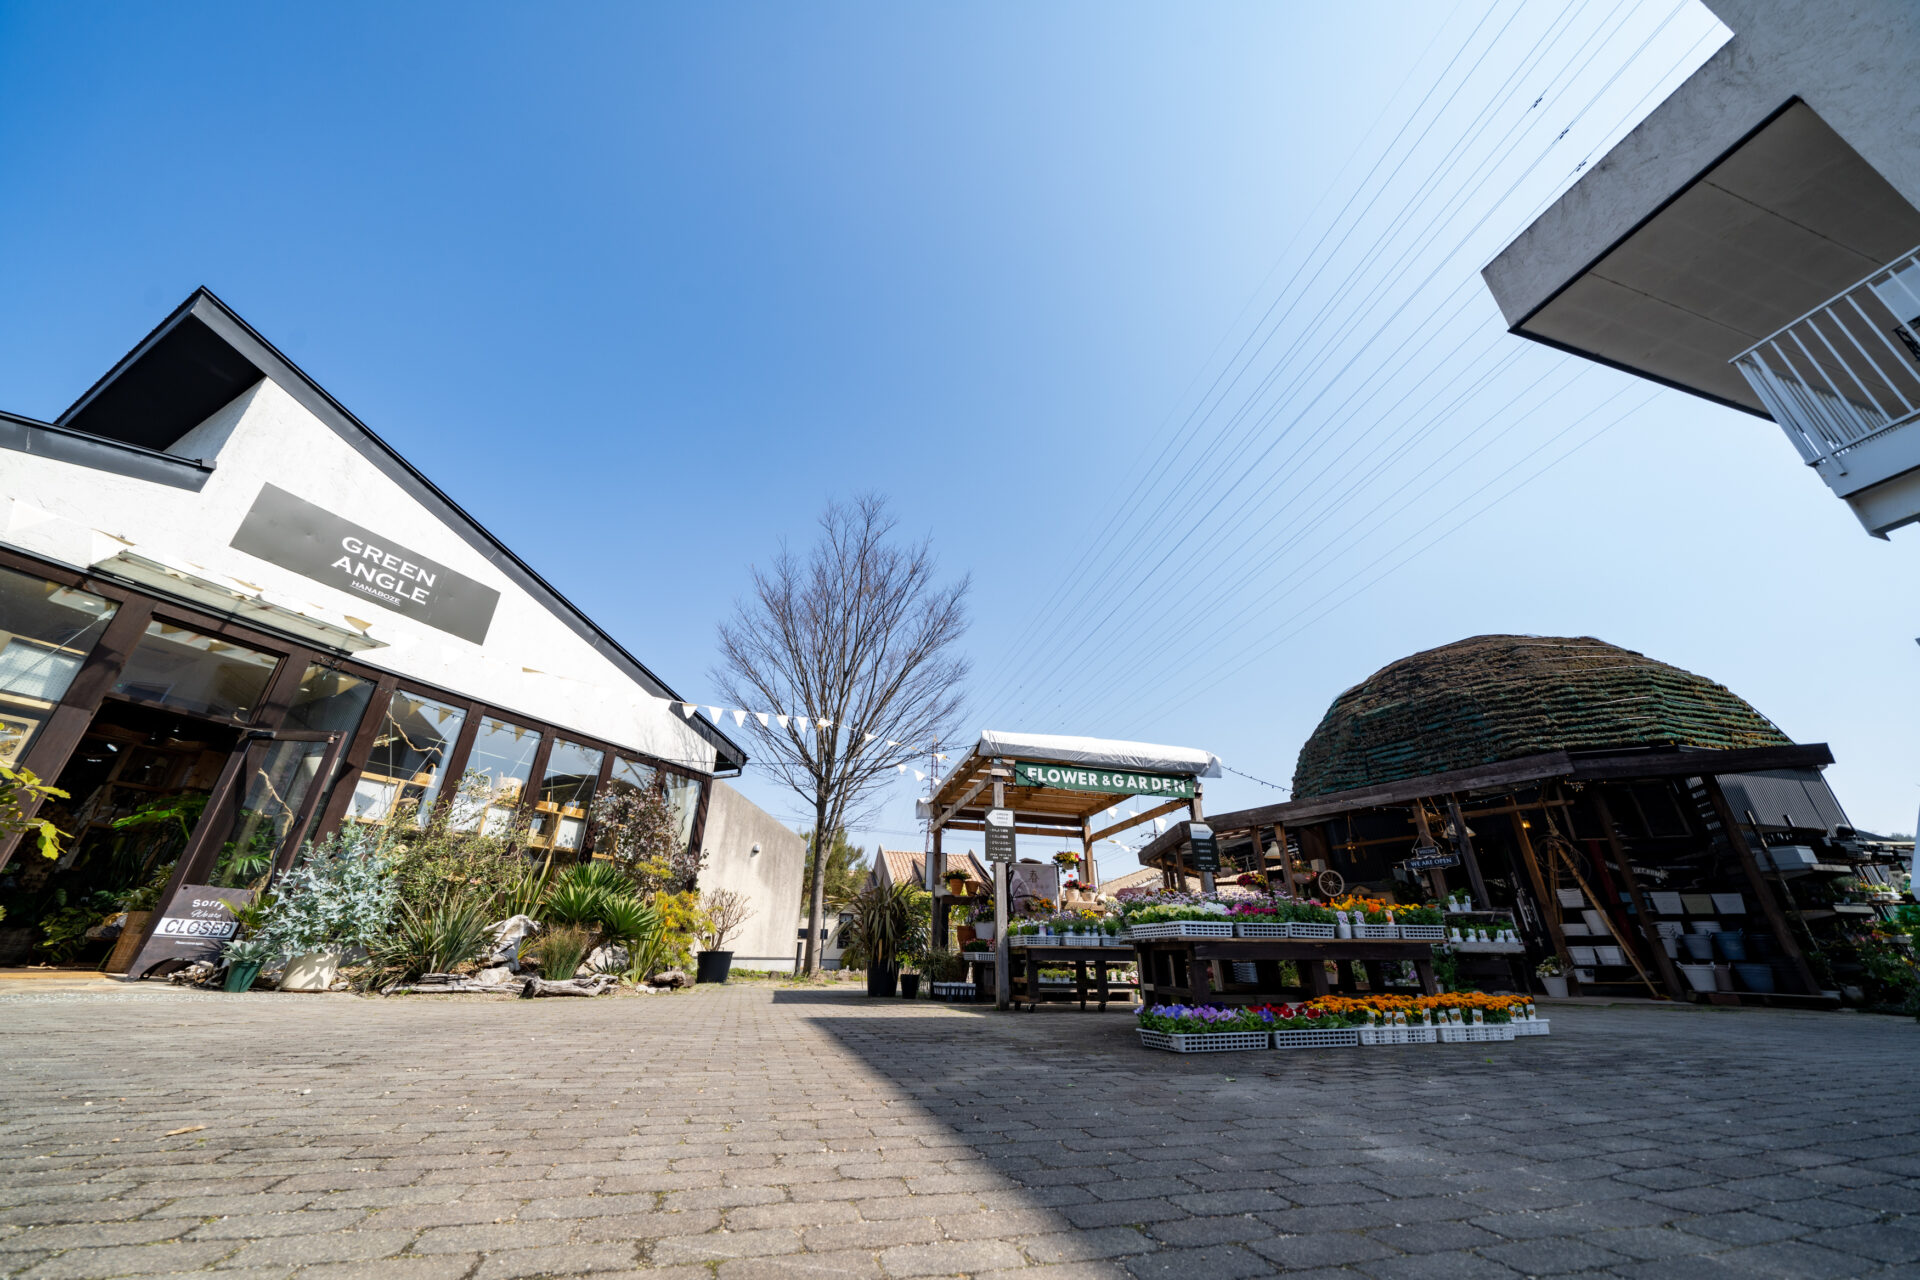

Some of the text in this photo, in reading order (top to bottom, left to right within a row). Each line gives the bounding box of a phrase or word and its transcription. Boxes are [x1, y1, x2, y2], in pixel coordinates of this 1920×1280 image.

[342, 537, 436, 587] GREEN
[331, 556, 430, 605] ANGLE
[351, 580, 401, 604] HANABOZE
[1027, 767, 1098, 786] FLOWER
[1112, 774, 1186, 793] GARDEN
[192, 899, 225, 911] Sorry
[164, 919, 233, 936] CLOSED
